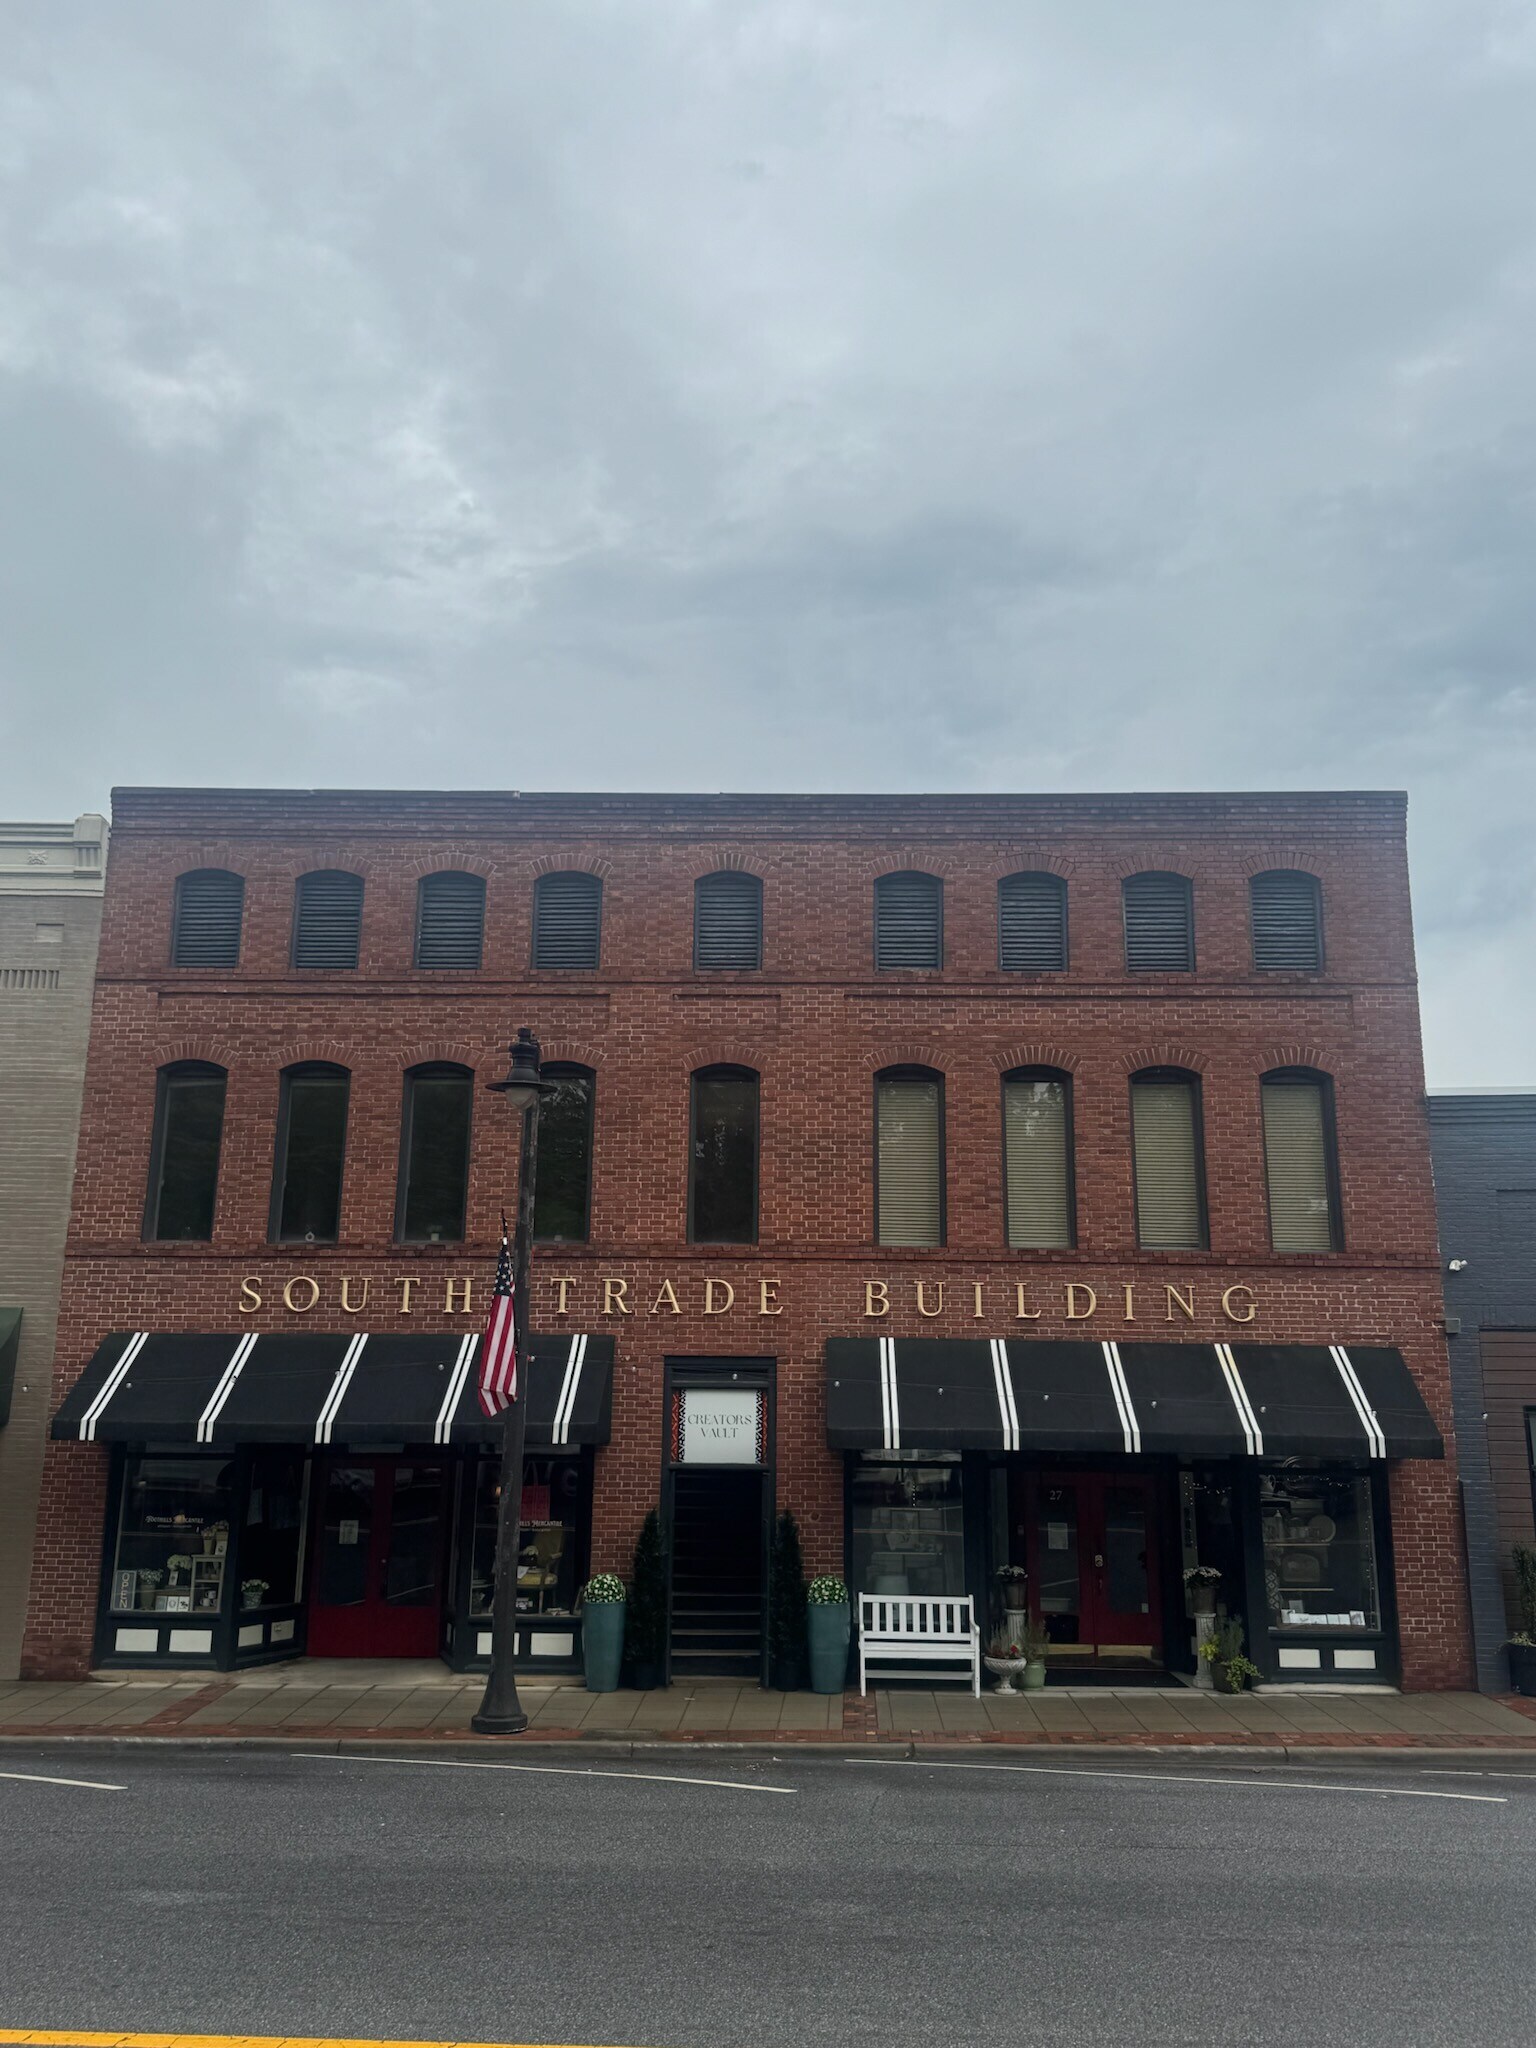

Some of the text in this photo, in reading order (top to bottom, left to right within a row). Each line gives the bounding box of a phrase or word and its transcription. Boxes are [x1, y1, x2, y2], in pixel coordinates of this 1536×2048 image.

[239, 1276, 1259, 1323] SOUTH TRADE BUILDING
[687, 1414, 752, 1425] CREATORS
[700, 1427, 739, 1438] VAULT
[1049, 1490, 1063, 1501] 27
[120, 1572, 130, 1609] OPEN
